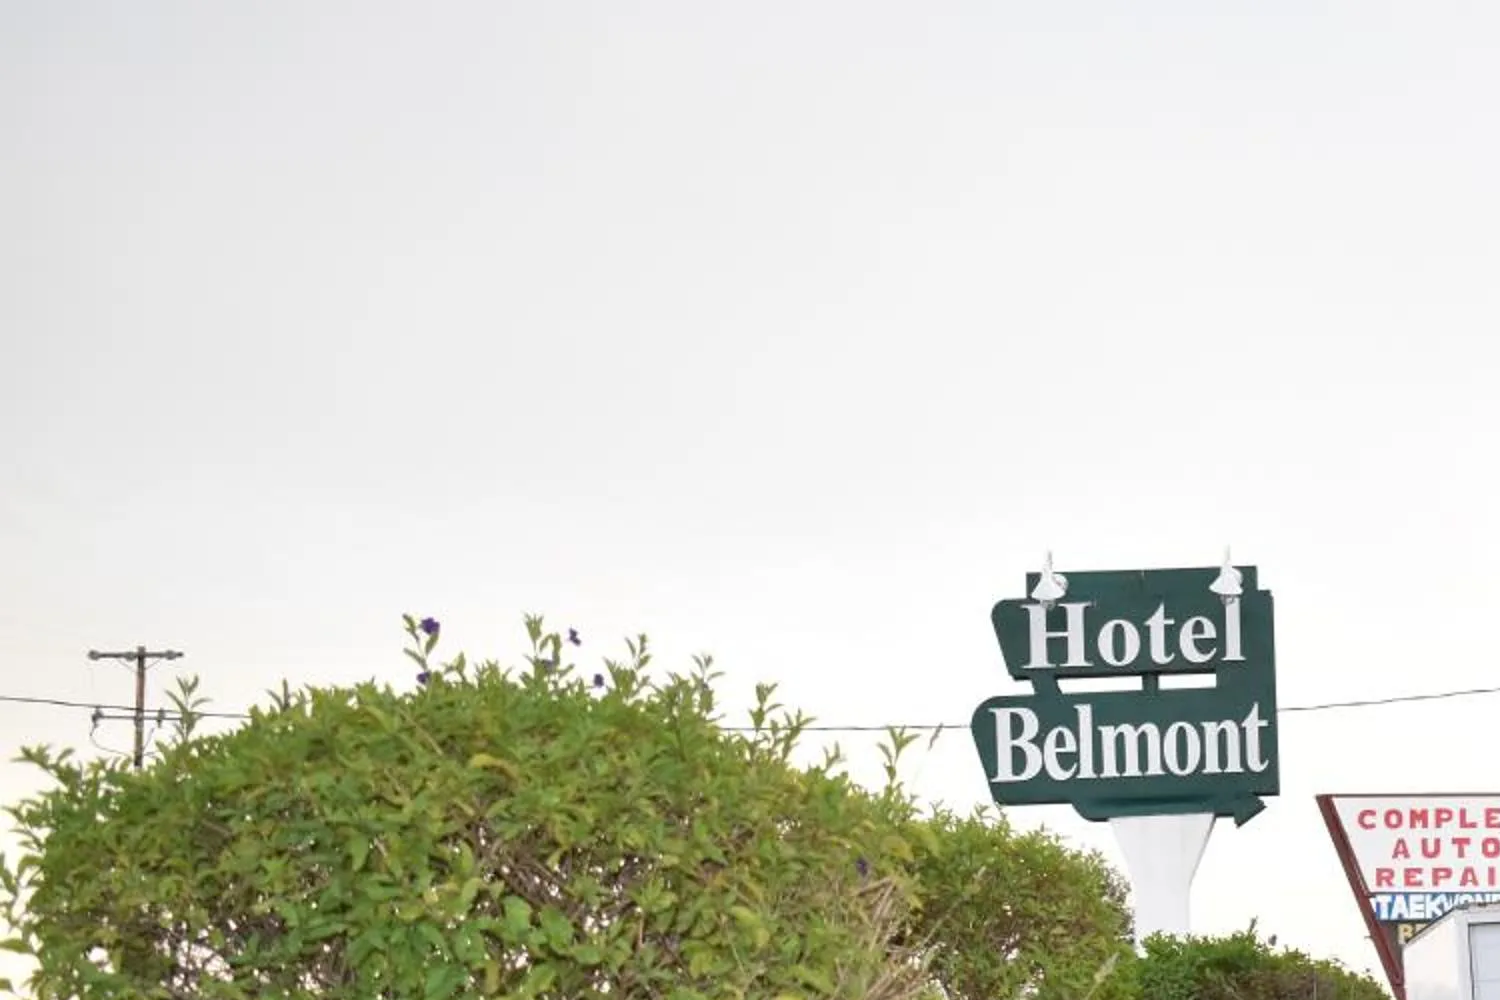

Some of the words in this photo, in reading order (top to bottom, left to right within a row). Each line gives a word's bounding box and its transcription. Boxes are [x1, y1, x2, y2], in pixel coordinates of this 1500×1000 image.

[1020, 597, 1246, 669] Hotel
[988, 702, 1269, 783] Belmont
[1391, 837, 1500, 859] AUTO
